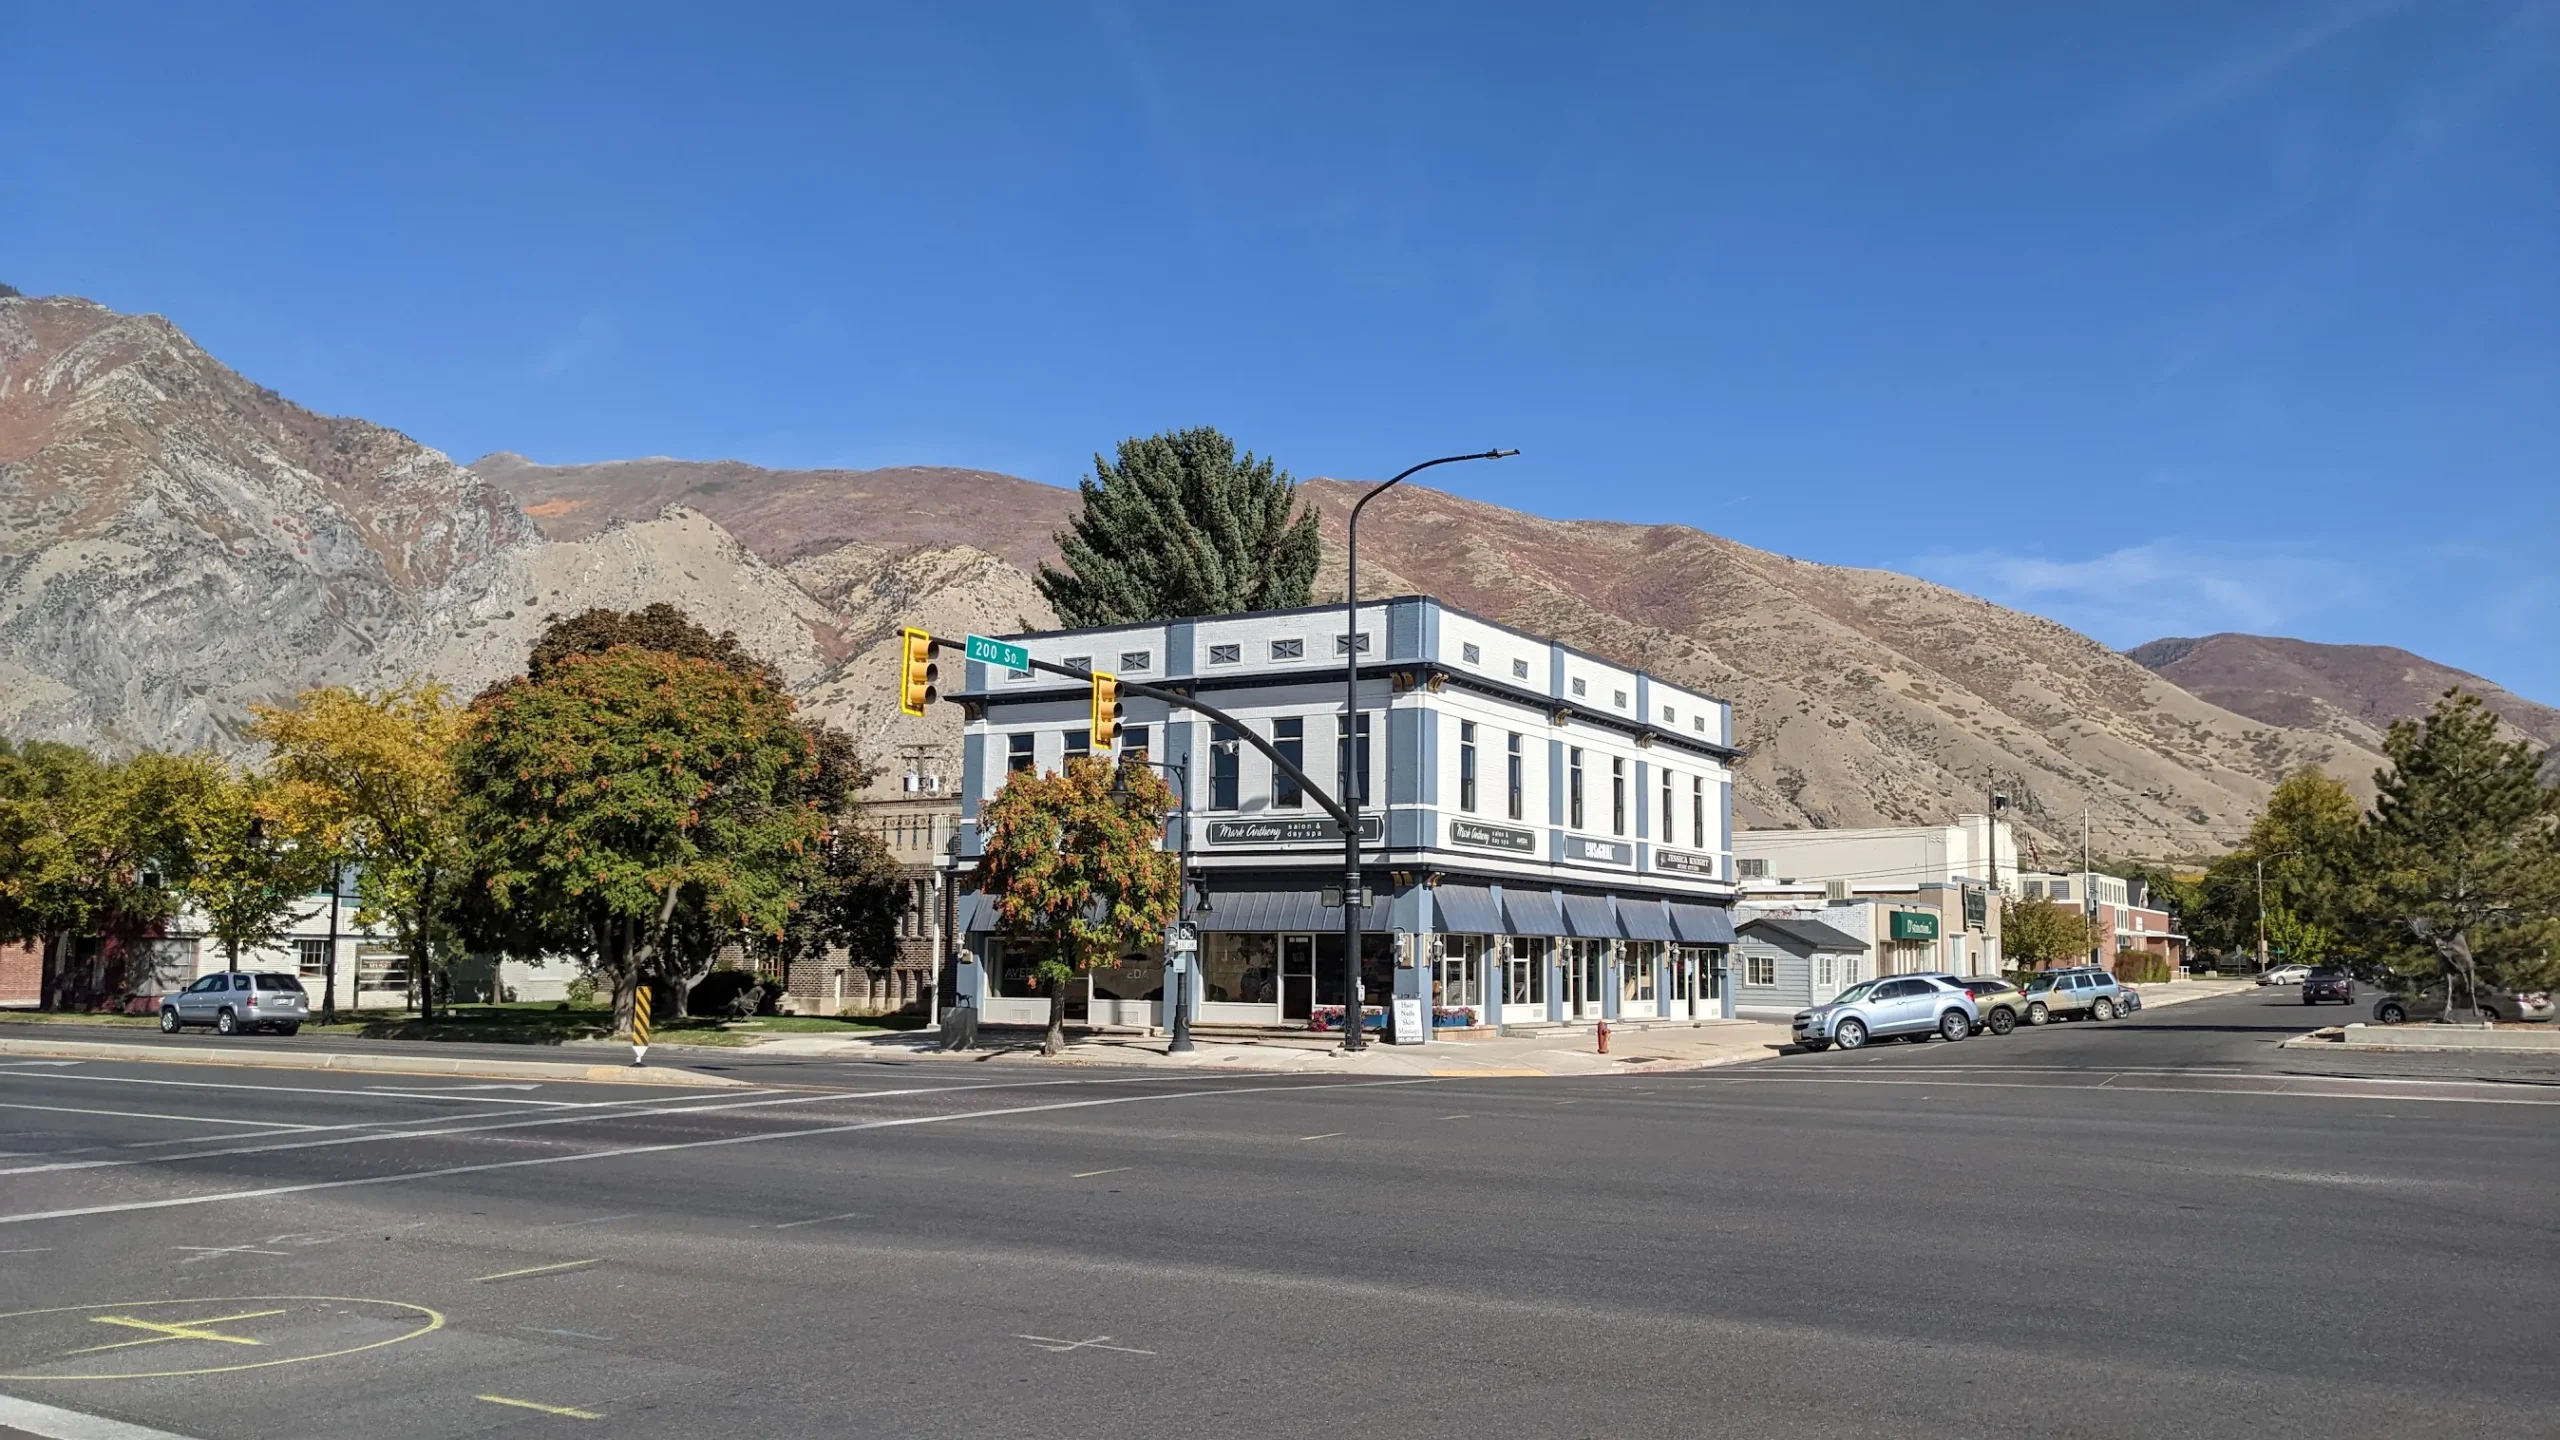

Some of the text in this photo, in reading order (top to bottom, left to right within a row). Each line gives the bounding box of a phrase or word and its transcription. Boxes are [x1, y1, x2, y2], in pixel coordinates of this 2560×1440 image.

[976, 641, 1019, 665] 200 So.
[1219, 823, 1282, 840] Mark Anthony
